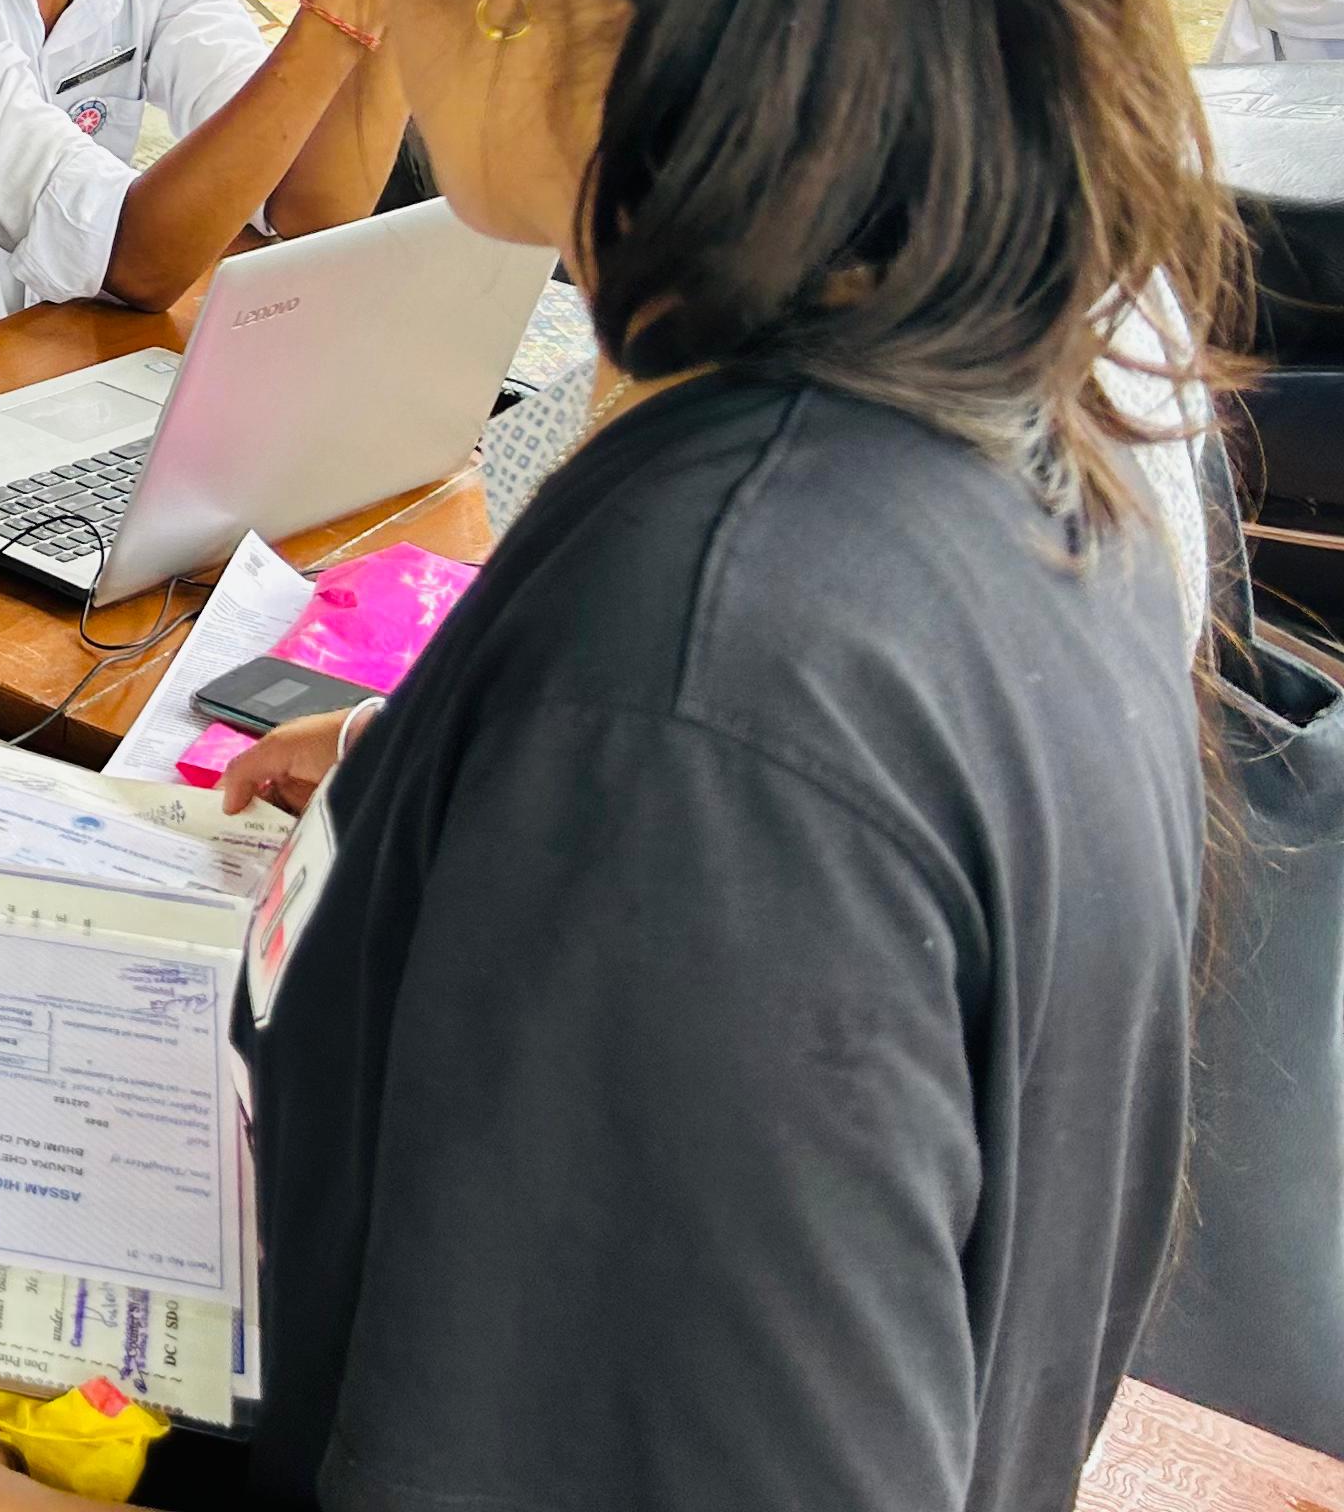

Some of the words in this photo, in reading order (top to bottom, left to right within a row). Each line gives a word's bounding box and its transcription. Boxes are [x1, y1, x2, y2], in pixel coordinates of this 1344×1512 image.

[231, 296, 301, 330] Lenovo
[24, 1181, 81, 1202] ASSAM
[161, 1343, 179, 1367] DC
